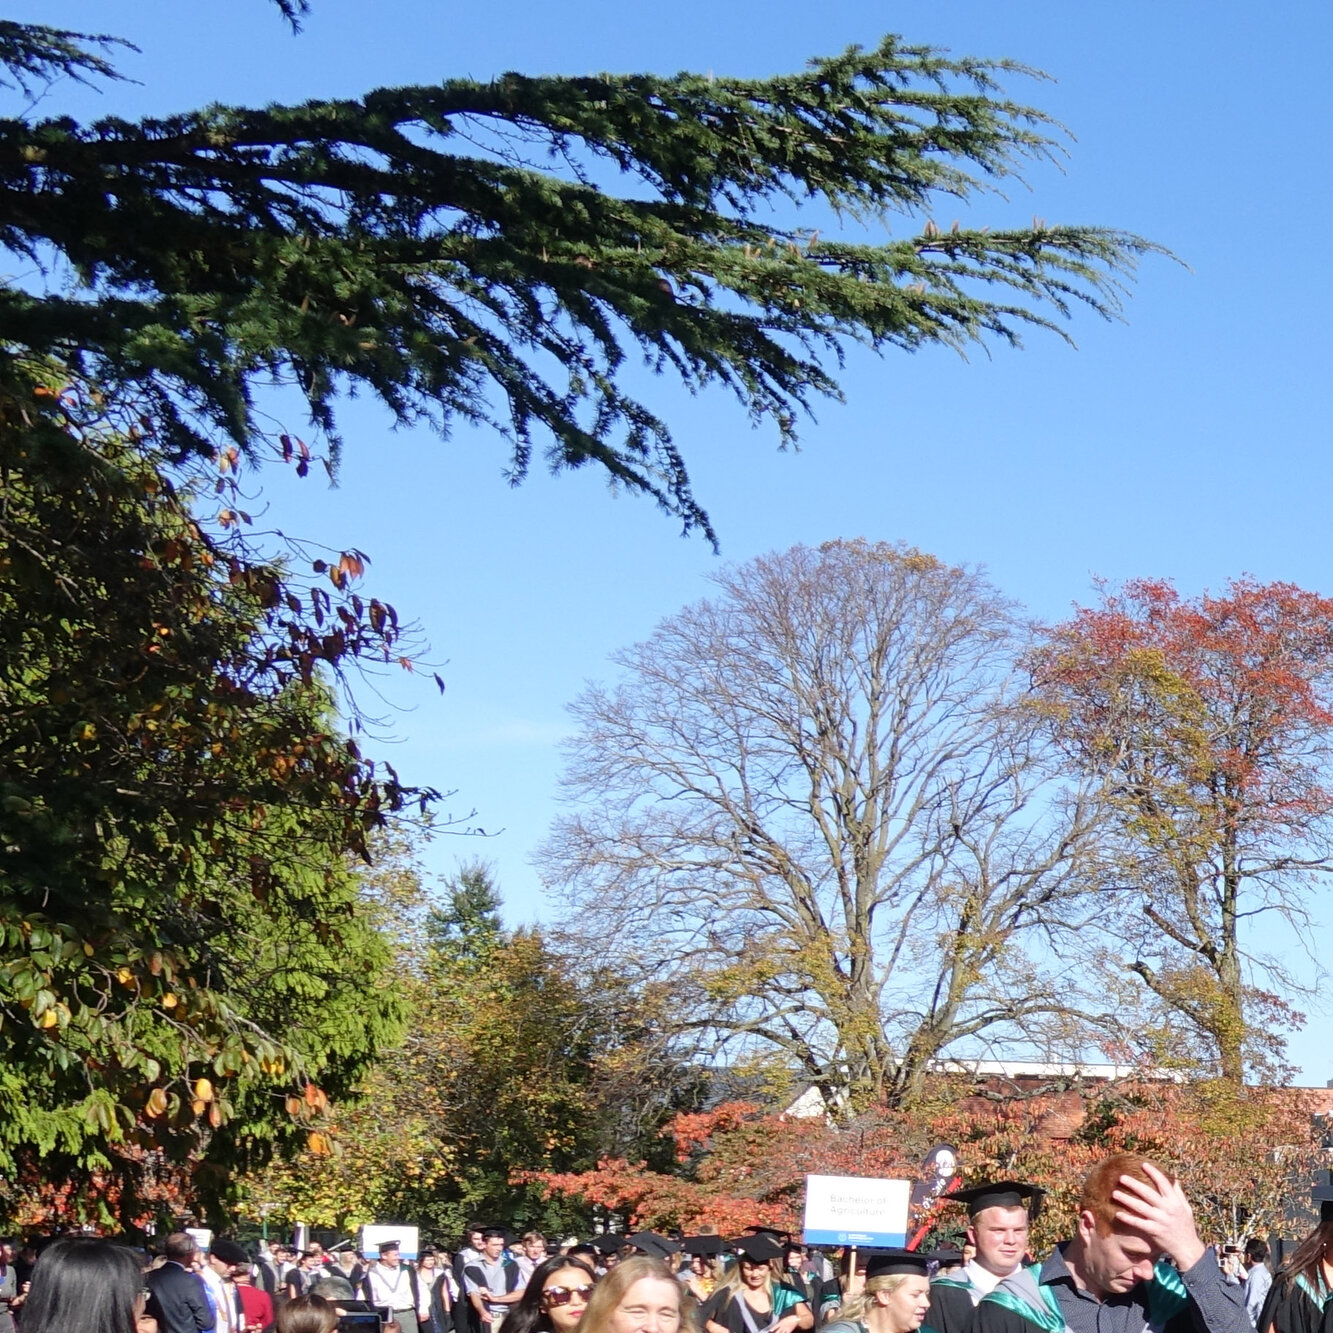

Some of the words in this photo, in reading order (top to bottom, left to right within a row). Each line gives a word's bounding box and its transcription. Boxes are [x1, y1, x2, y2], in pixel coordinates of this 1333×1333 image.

[830, 1193, 875, 1205] Bachelor
[877, 1196, 887, 1205] of
[830, 1205, 886, 1217] Agriculture
